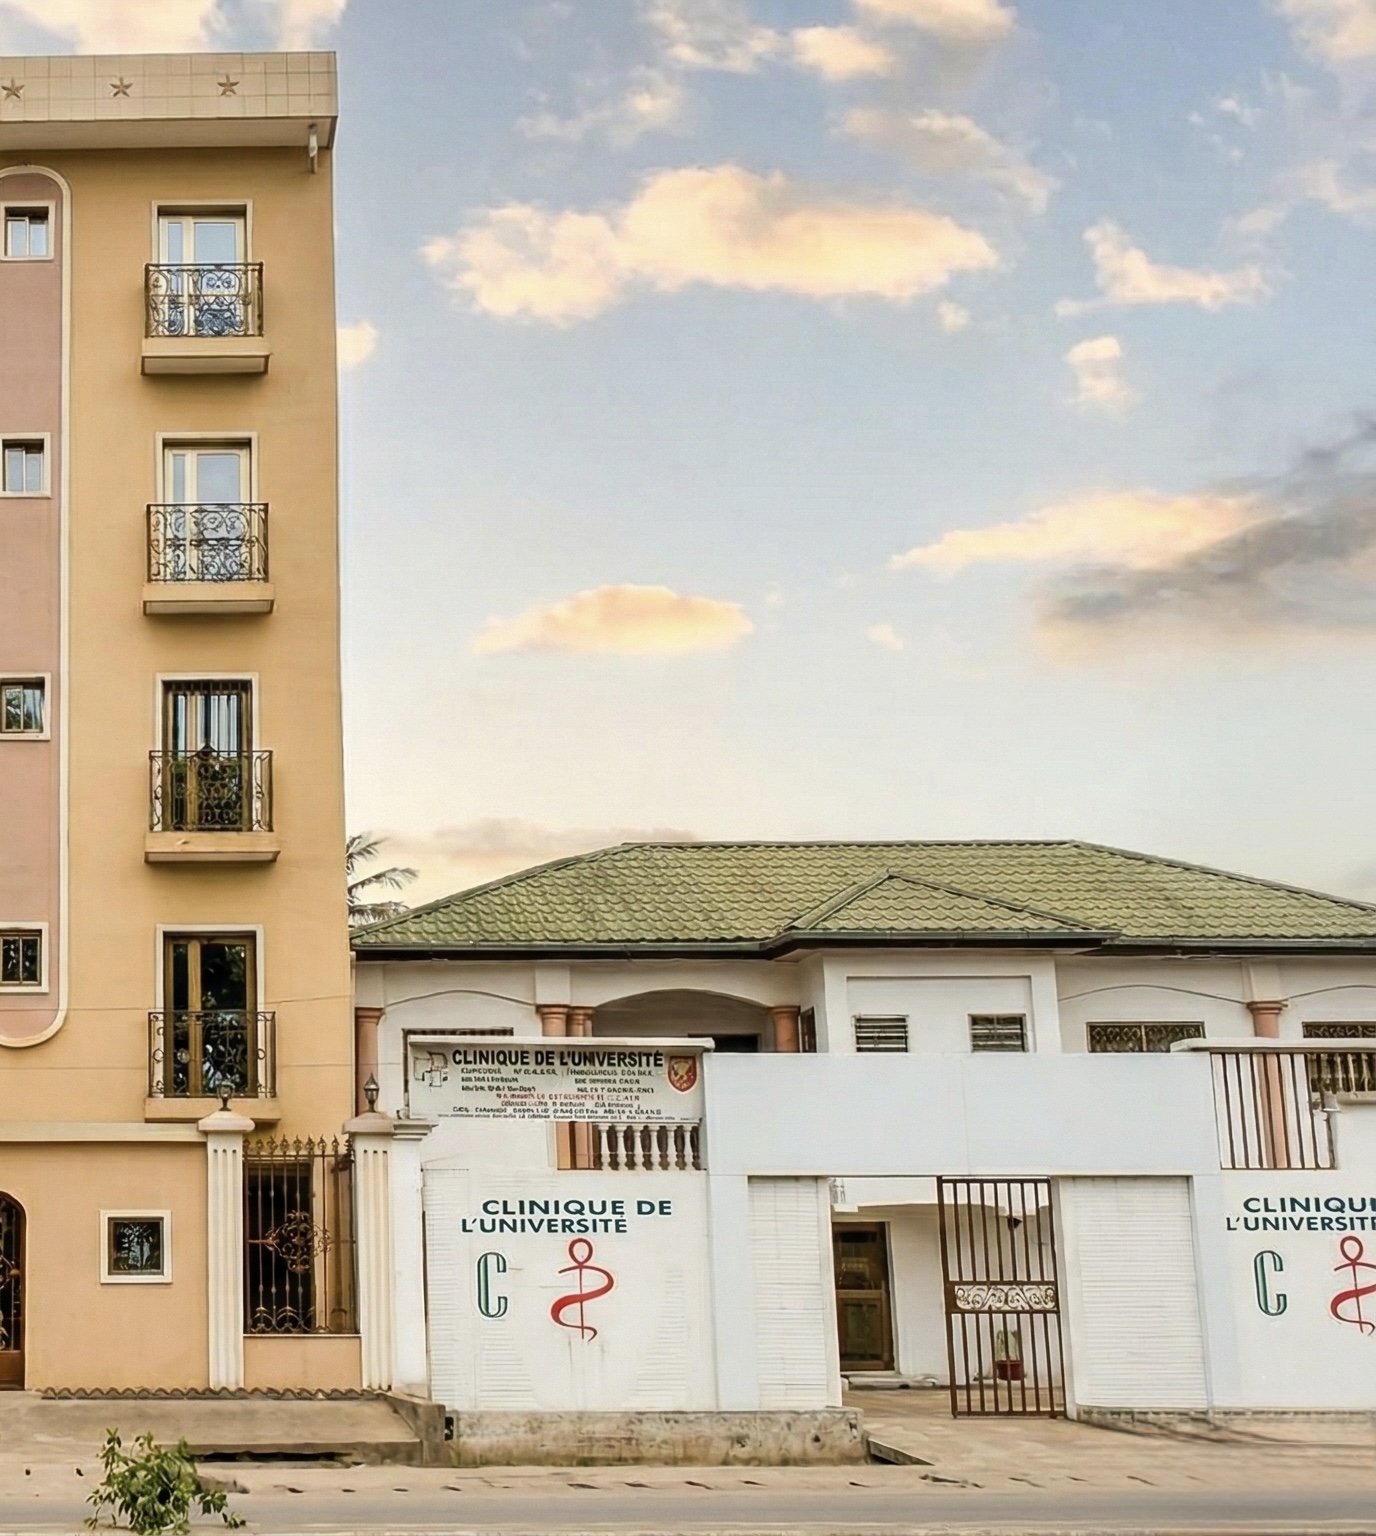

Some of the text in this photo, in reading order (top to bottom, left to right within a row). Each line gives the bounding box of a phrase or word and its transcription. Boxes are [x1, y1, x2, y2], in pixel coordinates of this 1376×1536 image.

[451, 1049, 530, 1067] CLINIQUE
[534, 1050, 556, 1067] DE
[481, 1199, 672, 1217] CLINIQUE DE
